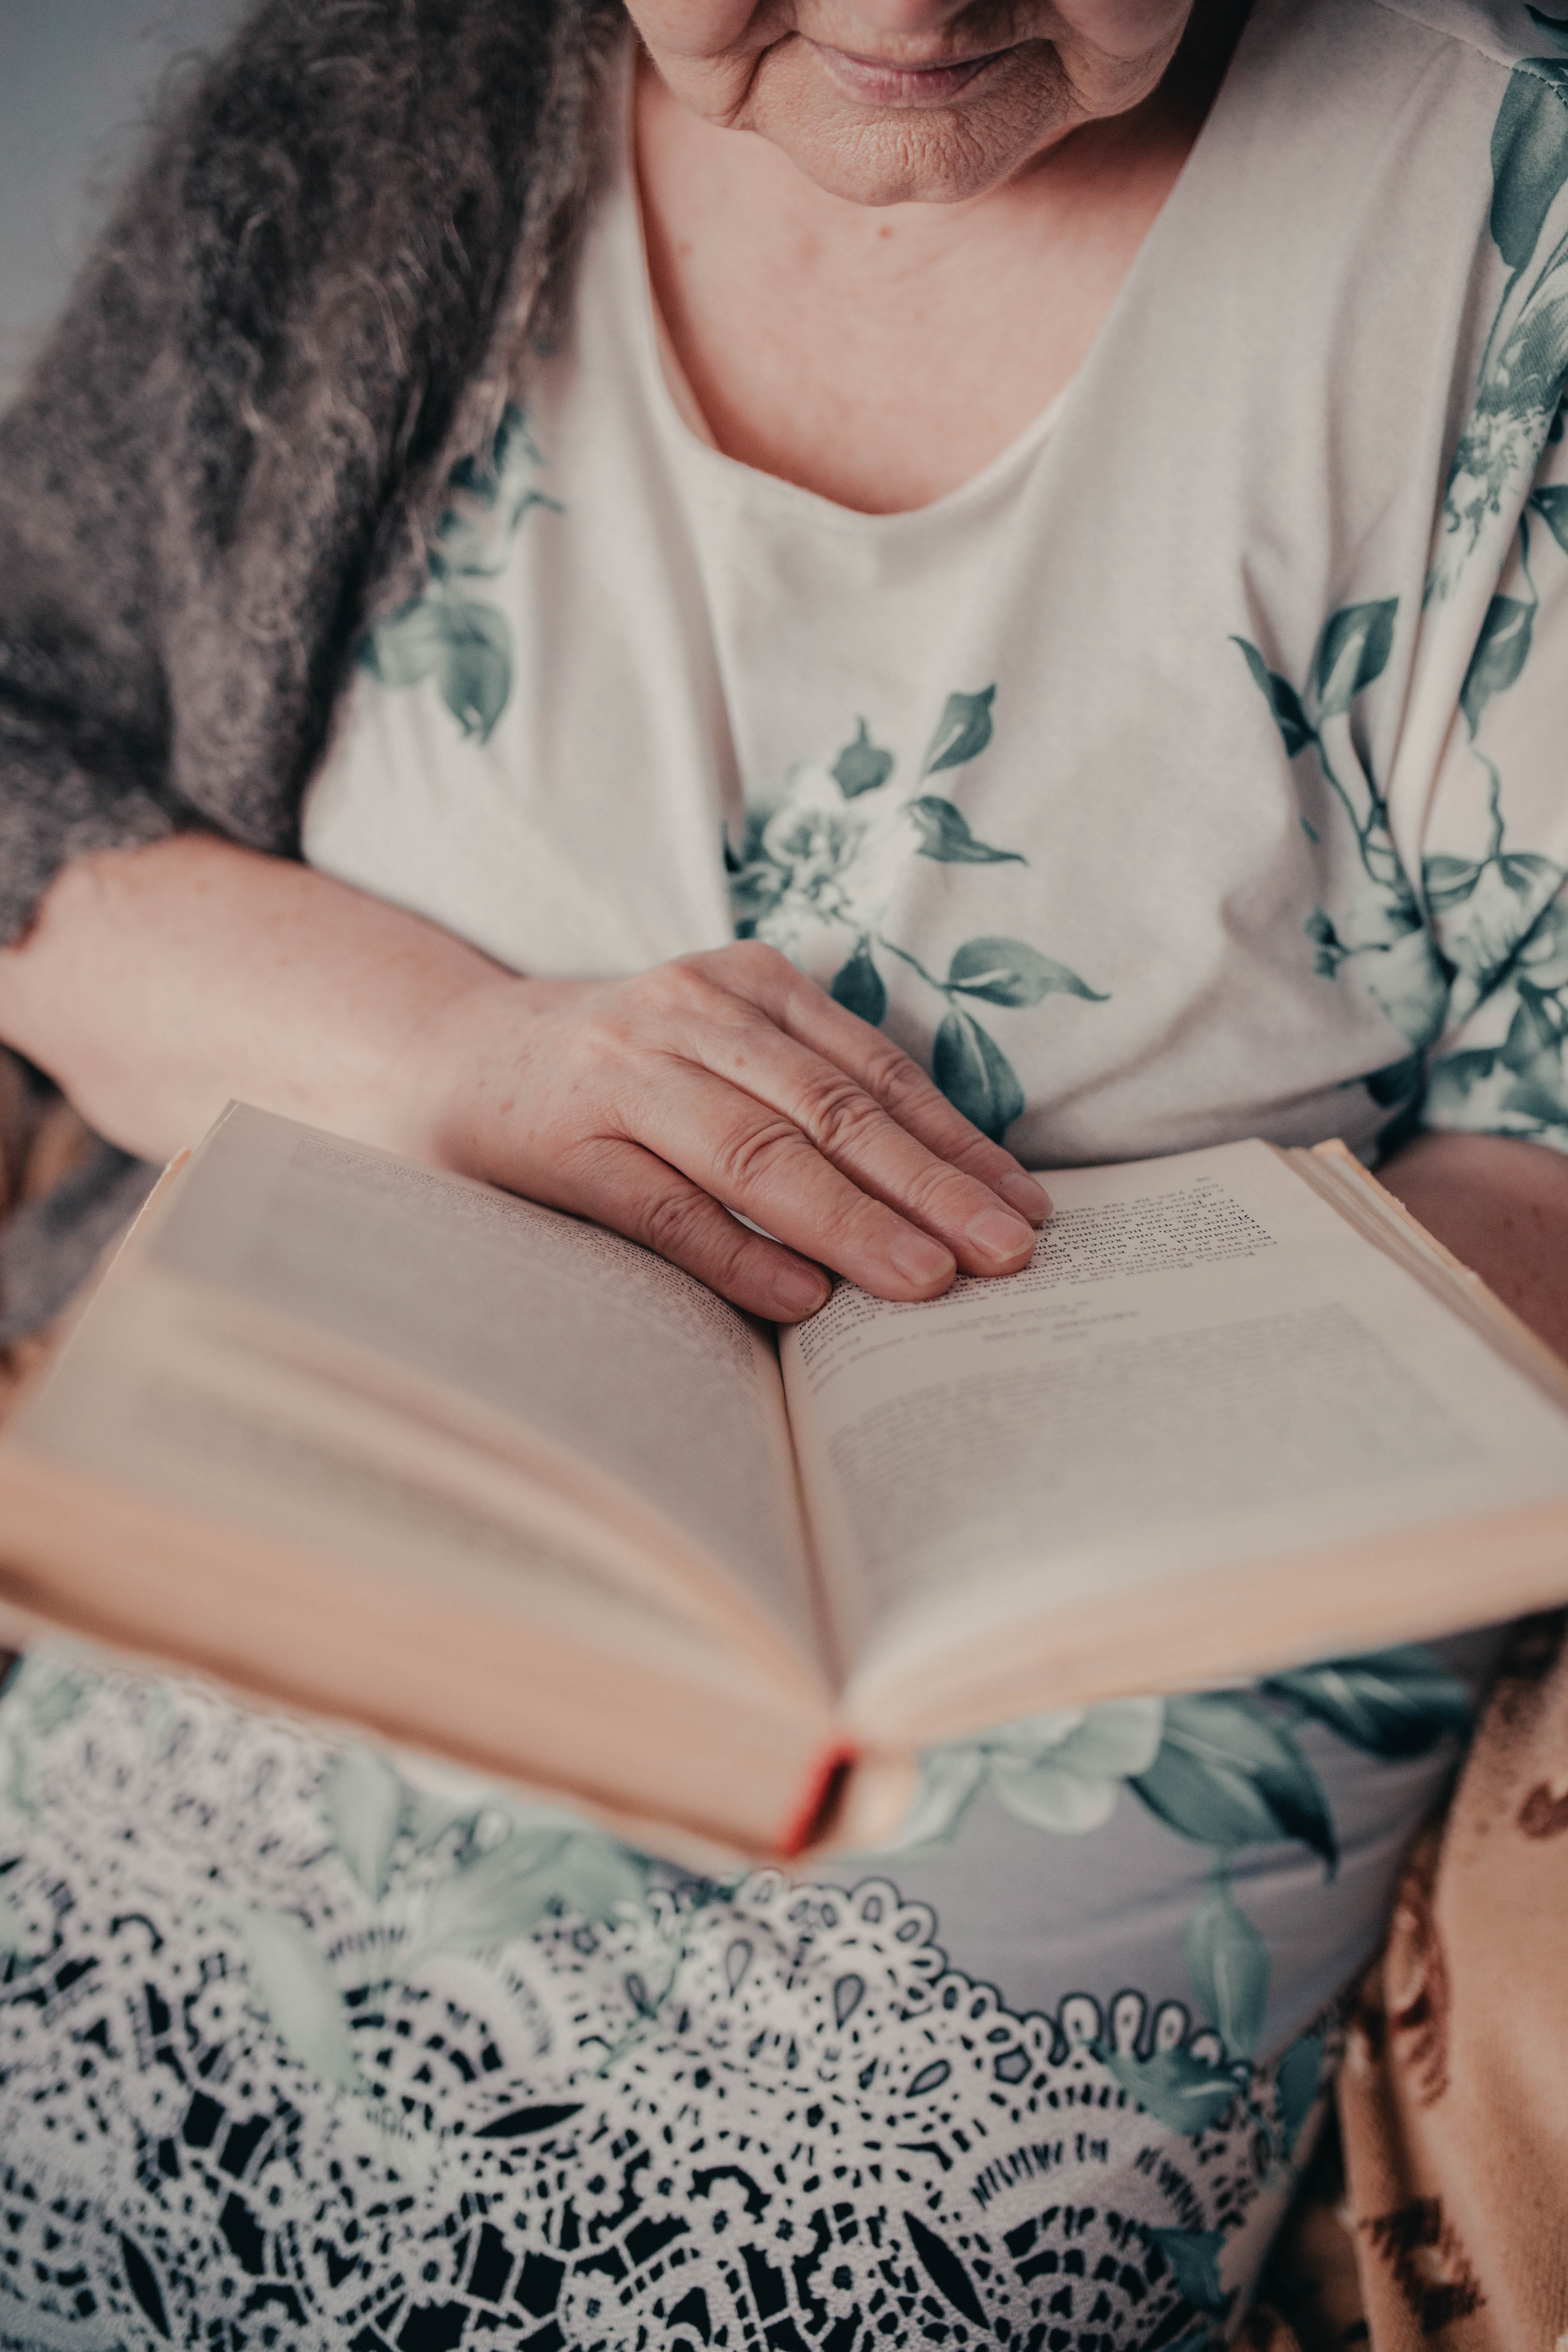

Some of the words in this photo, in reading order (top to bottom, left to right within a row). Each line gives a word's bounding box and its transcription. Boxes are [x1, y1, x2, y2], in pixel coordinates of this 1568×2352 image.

[1102, 1200, 1202, 1220] Возможность
[1060, 1217, 1132, 1234] женщина,
[1135, 1213, 1197, 1226] все-таки
[1178, 1216, 1209, 1224] том,
[1204, 1214, 1250, 1227] Ясное
[1058, 1226, 1125, 1240] красивая
[1159, 1224, 1196, 1234] дело,
[1169, 1219, 1255, 1239] говаривала
[1177, 1226, 1259, 1243] напомнила
[1063, 1229, 1142, 1245] позволила
[1217, 1233, 1250, 1242] г-же
[1073, 1239, 1122, 1250] хотела
[1084, 1244, 1126, 1255] мной,
[1194, 1240, 1277, 1259] старинной
[1034, 1248, 1066, 1256] дать
[1083, 1251, 1125, 1260] какое
[1129, 1246, 1187, 1258] Реналь.
[1161, 1246, 1211, 1259] время,
[1017, 1259, 1142, 1283] позавчерашнего
[828, 1294, 848, 1310] она
